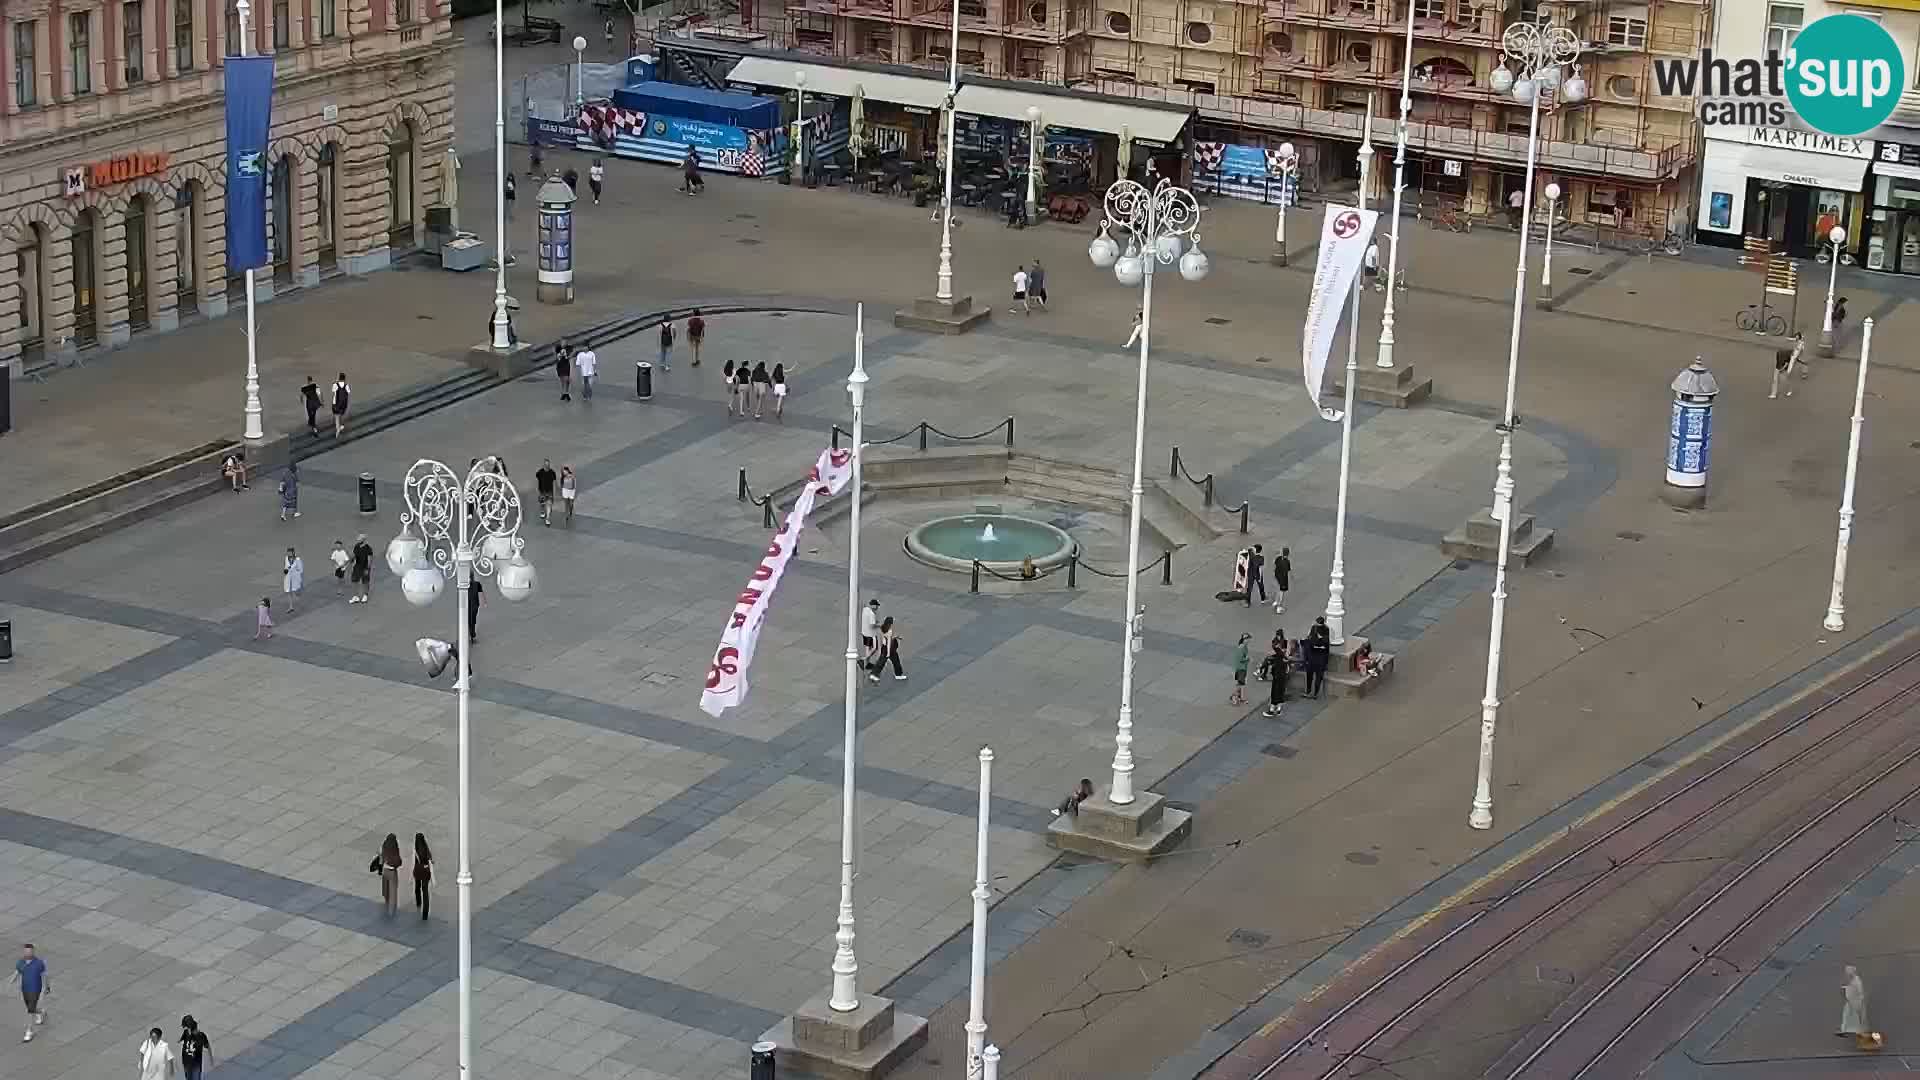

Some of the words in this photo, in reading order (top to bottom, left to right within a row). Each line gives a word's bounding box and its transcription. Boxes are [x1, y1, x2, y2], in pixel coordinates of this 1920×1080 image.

[1752, 127, 1864, 154] MARTIMEX
[89, 152, 169, 187] Müller
[1782, 174, 1821, 186] CHANEL
